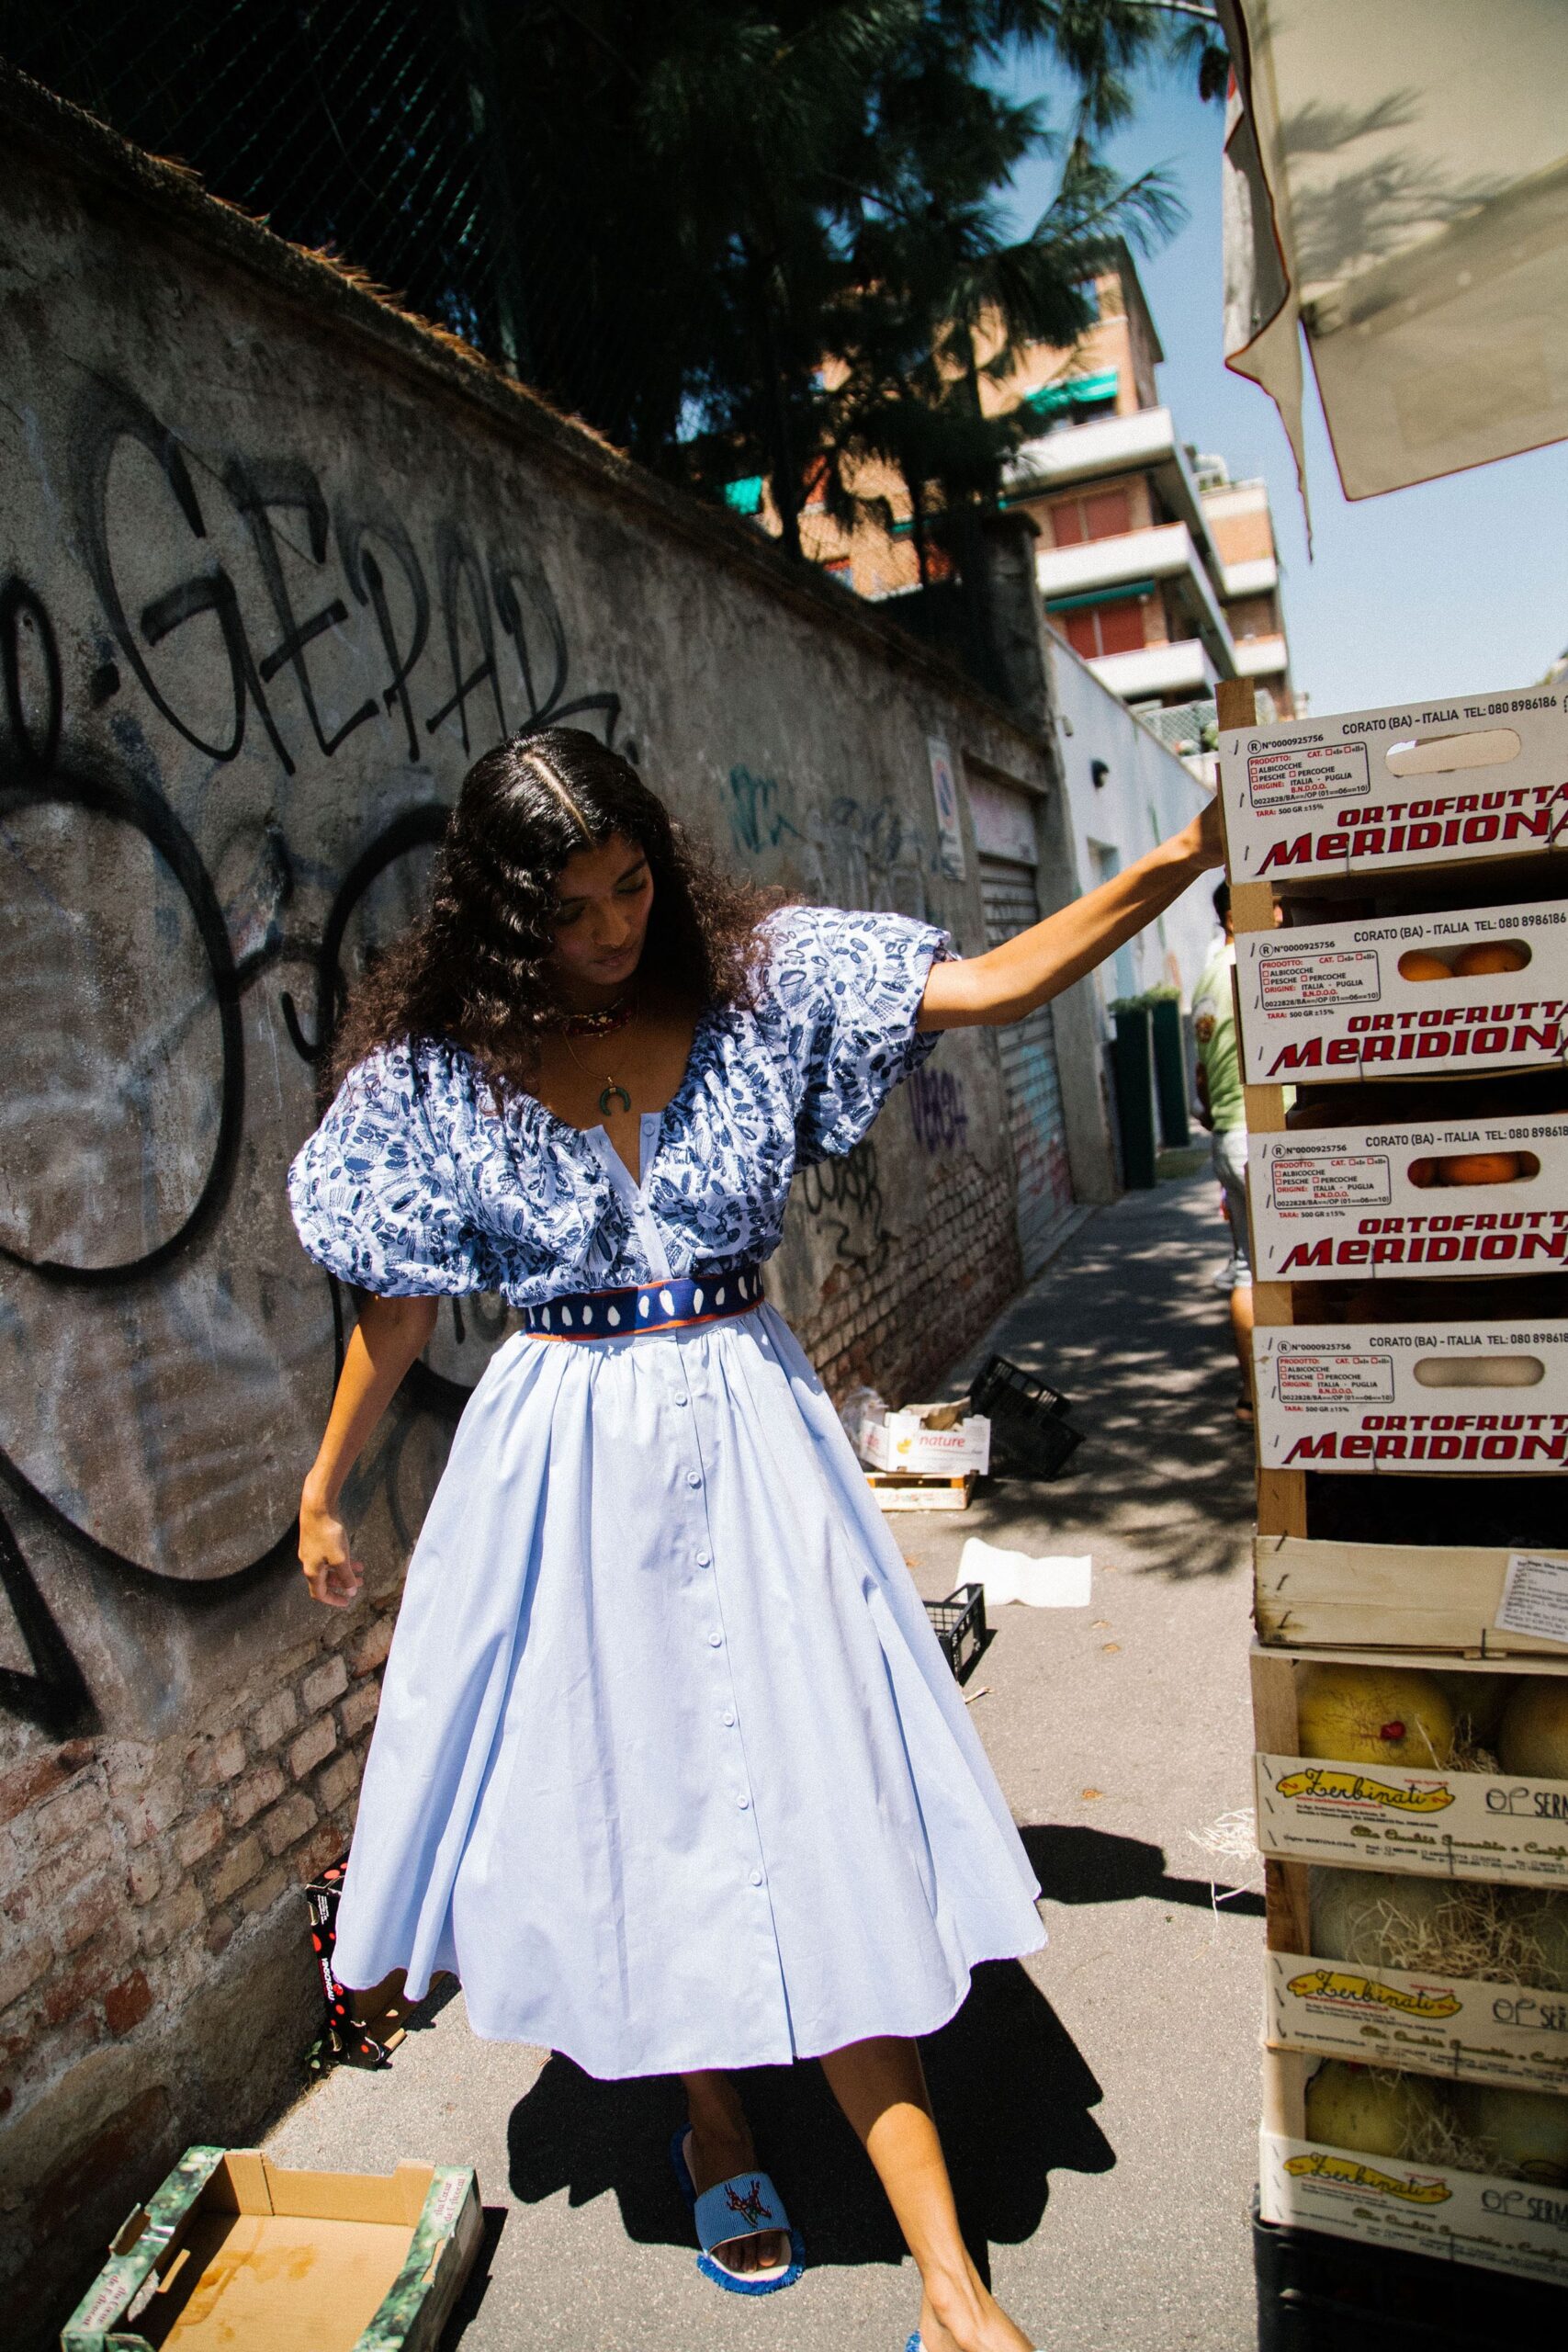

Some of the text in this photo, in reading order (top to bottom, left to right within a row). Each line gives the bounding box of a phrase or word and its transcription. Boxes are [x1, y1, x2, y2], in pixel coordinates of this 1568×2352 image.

[1341, 718, 1386, 735] CORATO
[1388, 715, 1412, 729] (BA)
[1422, 709, 1459, 724] ITALIA
[1487, 701, 1508, 715] 080
[1510, 695, 1556, 712] 8986186
[1250, 754, 1291, 765] PRODOTTO:
[1307, 750, 1323, 758] CAT.
[1258, 762, 1302, 773] ALBICOCCHE
[1259, 766, 1335, 781] PESCHE PERCOCHE
[1253, 781, 1284, 790] ORIGINE:
[1290, 777, 1312, 786] ITALIA
[1325, 772, 1351, 781] PUGLIA
[1353, 928, 1397, 942] CORATO
[1399, 925, 1423, 939] (BA)
[1433, 922, 1469, 935] ITALIA
[1498, 916, 1518, 928] 080
[1521, 912, 1565, 926] 8986186
[1261, 959, 1303, 968] PRODOTTO:
[1269, 967, 1313, 976] ALBICOCCHE
[1309, 972, 1346, 981] PERCOCHE
[1365, 1135, 1408, 1147] CORATO
[1410, 1133, 1434, 1146] (BA)
[1444, 1131, 1480, 1143] ITALIA
[1508, 1127, 1529, 1138] 080
[1359, 1210, 1568, 1235] ORTOFRUTT
[1369, 1336, 1412, 1346] CORATO
[1414, 1335, 1437, 1347] (BA)
[1447, 1335, 1482, 1345] ITALIA
[1510, 1334, 1529, 1343] 080
[1361, 1415, 1568, 1434] ORTOFRUTT
[919, 1436, 965, 1448] nature
[1304, 1768, 1427, 1804] Zerbinati
[1485, 1787, 1529, 1815] OP
